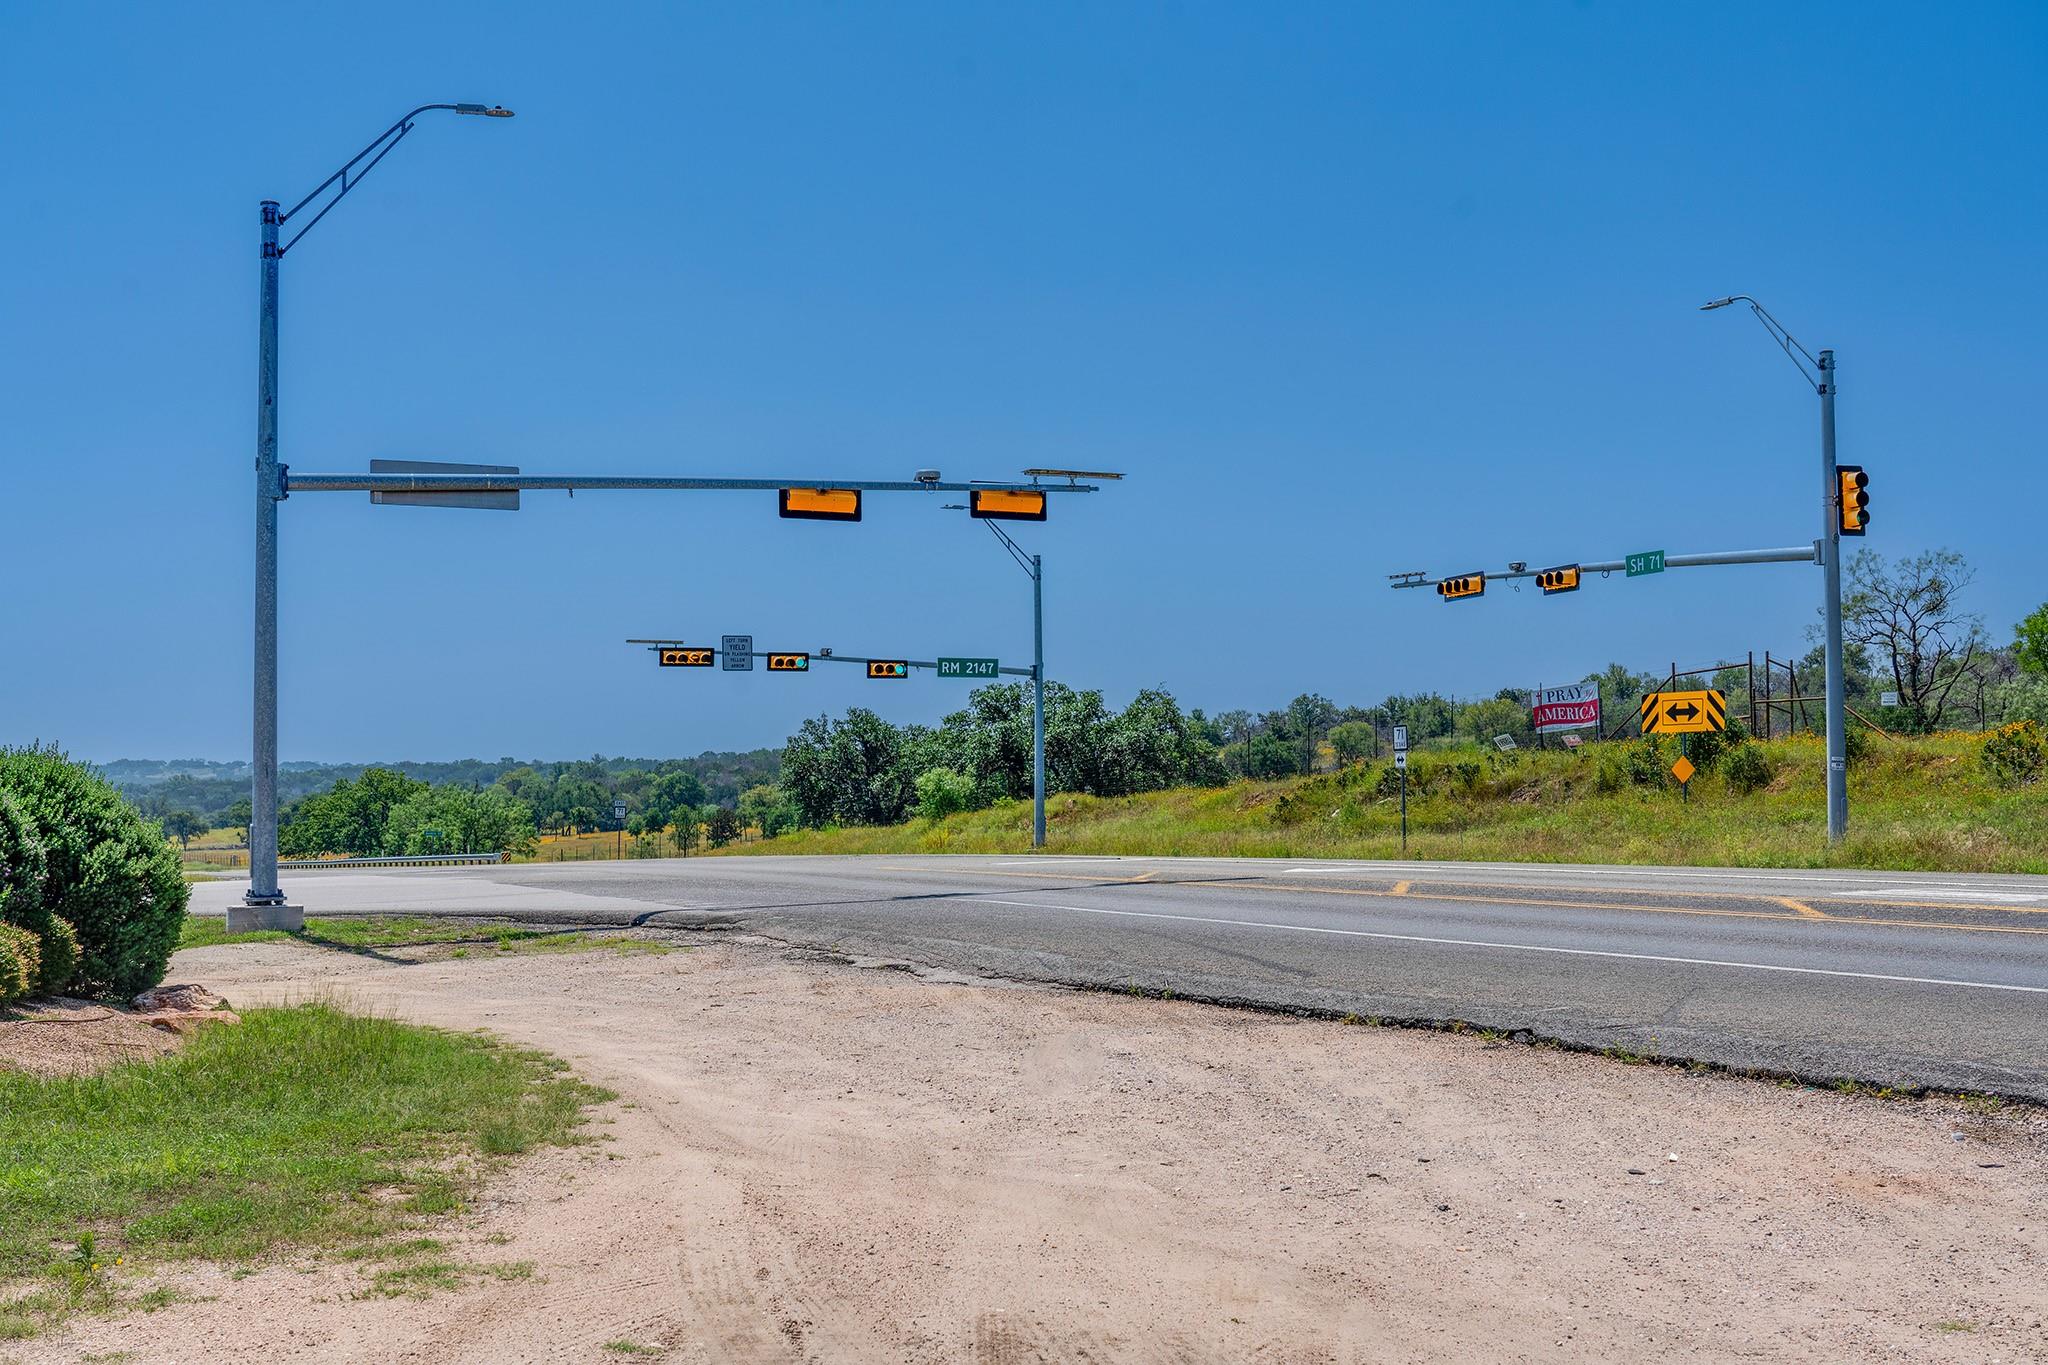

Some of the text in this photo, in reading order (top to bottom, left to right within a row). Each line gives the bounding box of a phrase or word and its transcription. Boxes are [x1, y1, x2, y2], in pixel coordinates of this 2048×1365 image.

[1630, 554, 1660, 573] SH 71
[942, 661, 994, 674] RM 2147
[1546, 686, 1583, 703] PRAY
[1537, 704, 1596, 724] AMERICA
[1396, 729, 1404, 740] 71
